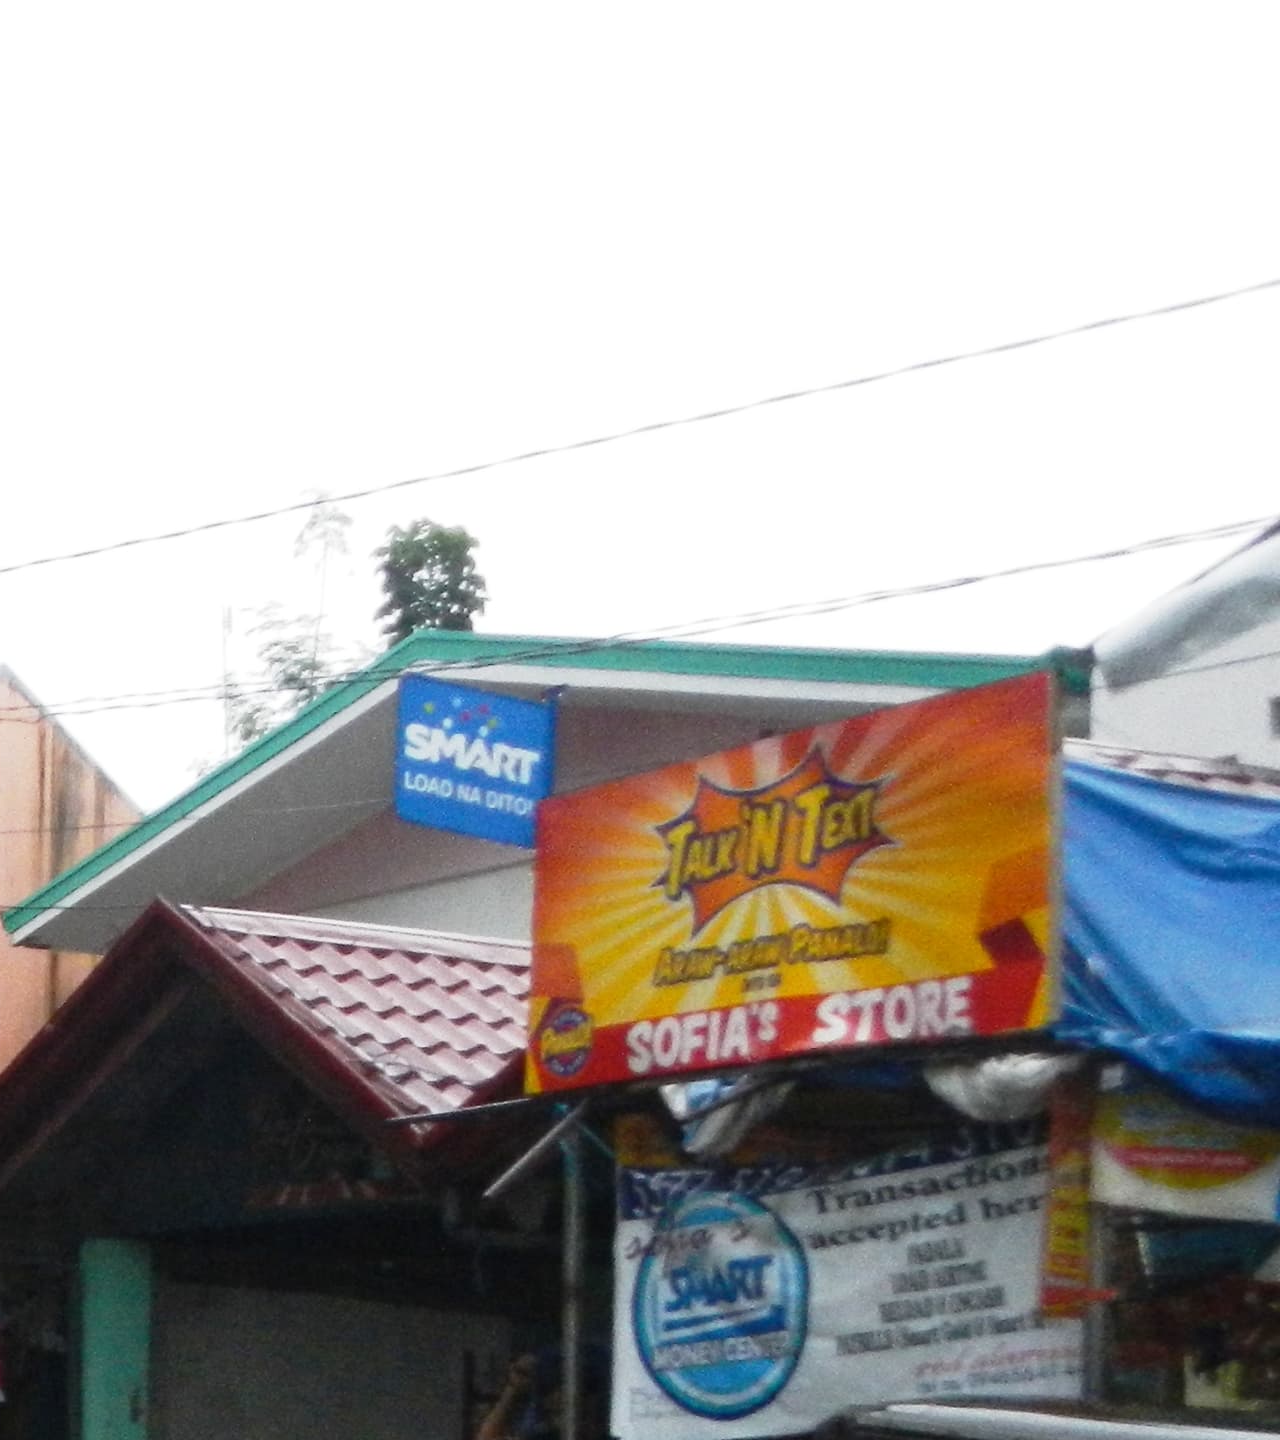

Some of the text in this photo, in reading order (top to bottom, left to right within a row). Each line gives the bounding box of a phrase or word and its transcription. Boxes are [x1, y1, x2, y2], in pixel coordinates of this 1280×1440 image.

[404, 722, 541, 785] SMART
[403, 770, 454, 798] LOAD
[456, 784, 481, 804] NA
[625, 1001, 781, 1074] SOFIA'S
[811, 975, 973, 1045] STORE
[808, 1194, 1046, 1250] accepted her
[664, 1255, 774, 1313] SMART
